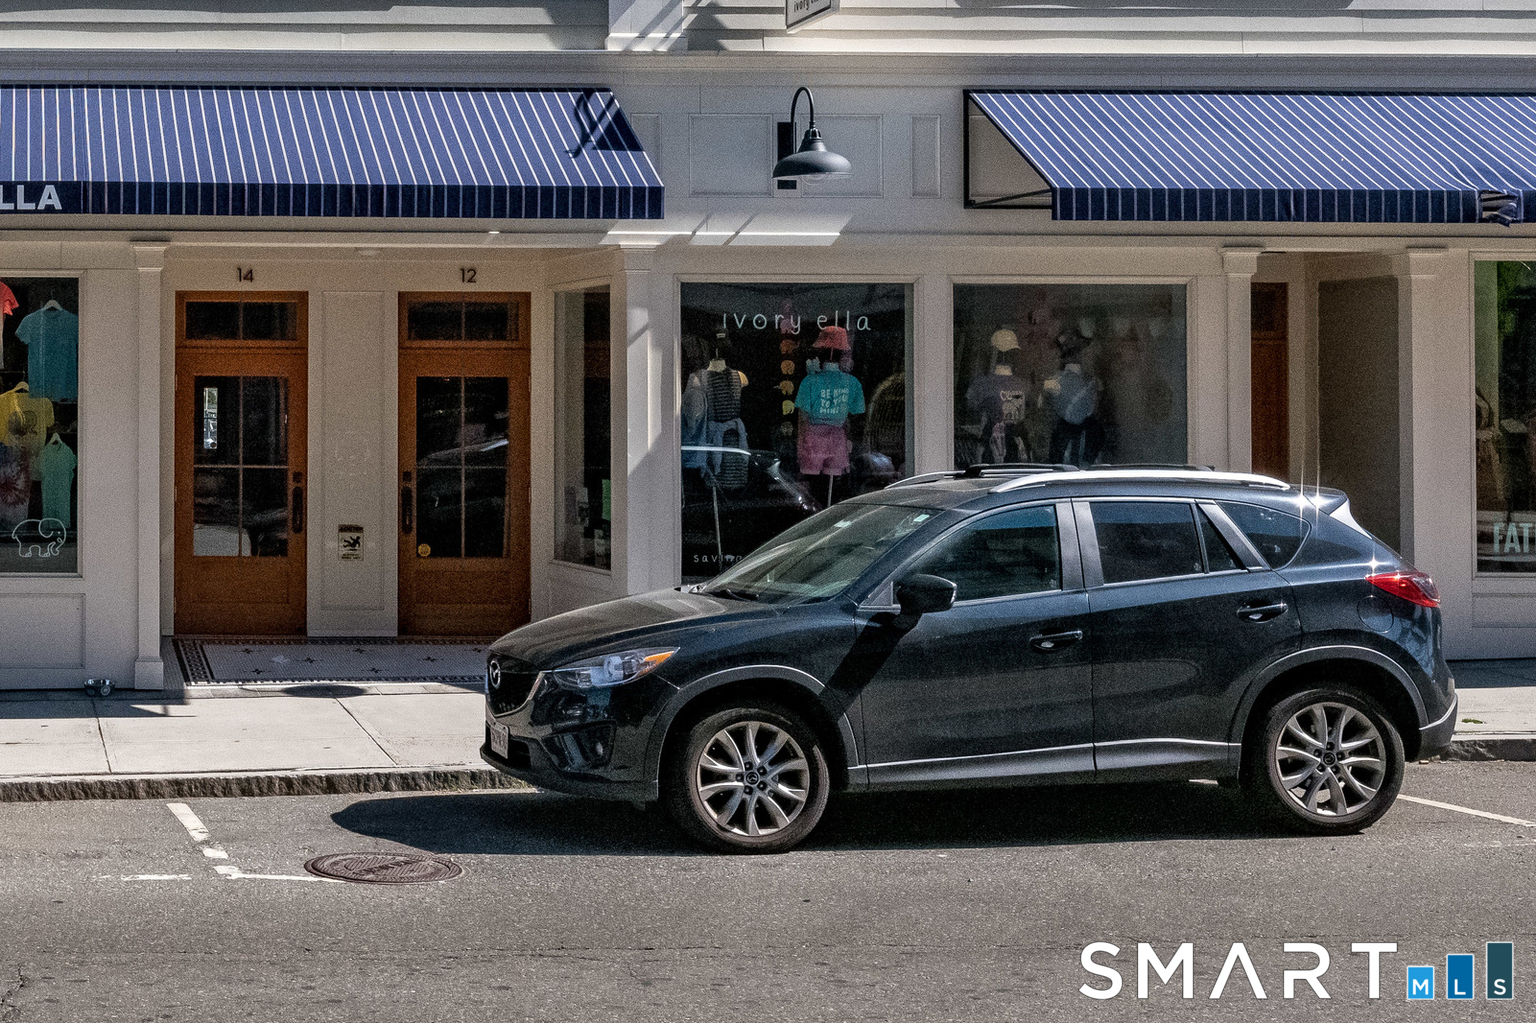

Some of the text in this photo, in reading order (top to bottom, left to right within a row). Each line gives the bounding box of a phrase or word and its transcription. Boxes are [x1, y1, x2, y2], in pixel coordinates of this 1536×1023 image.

[236, 267, 254, 283] 14
[459, 267, 477, 284] 12
[723, 310, 872, 335] ivory ella
[1493, 522, 1536, 553] FAT
